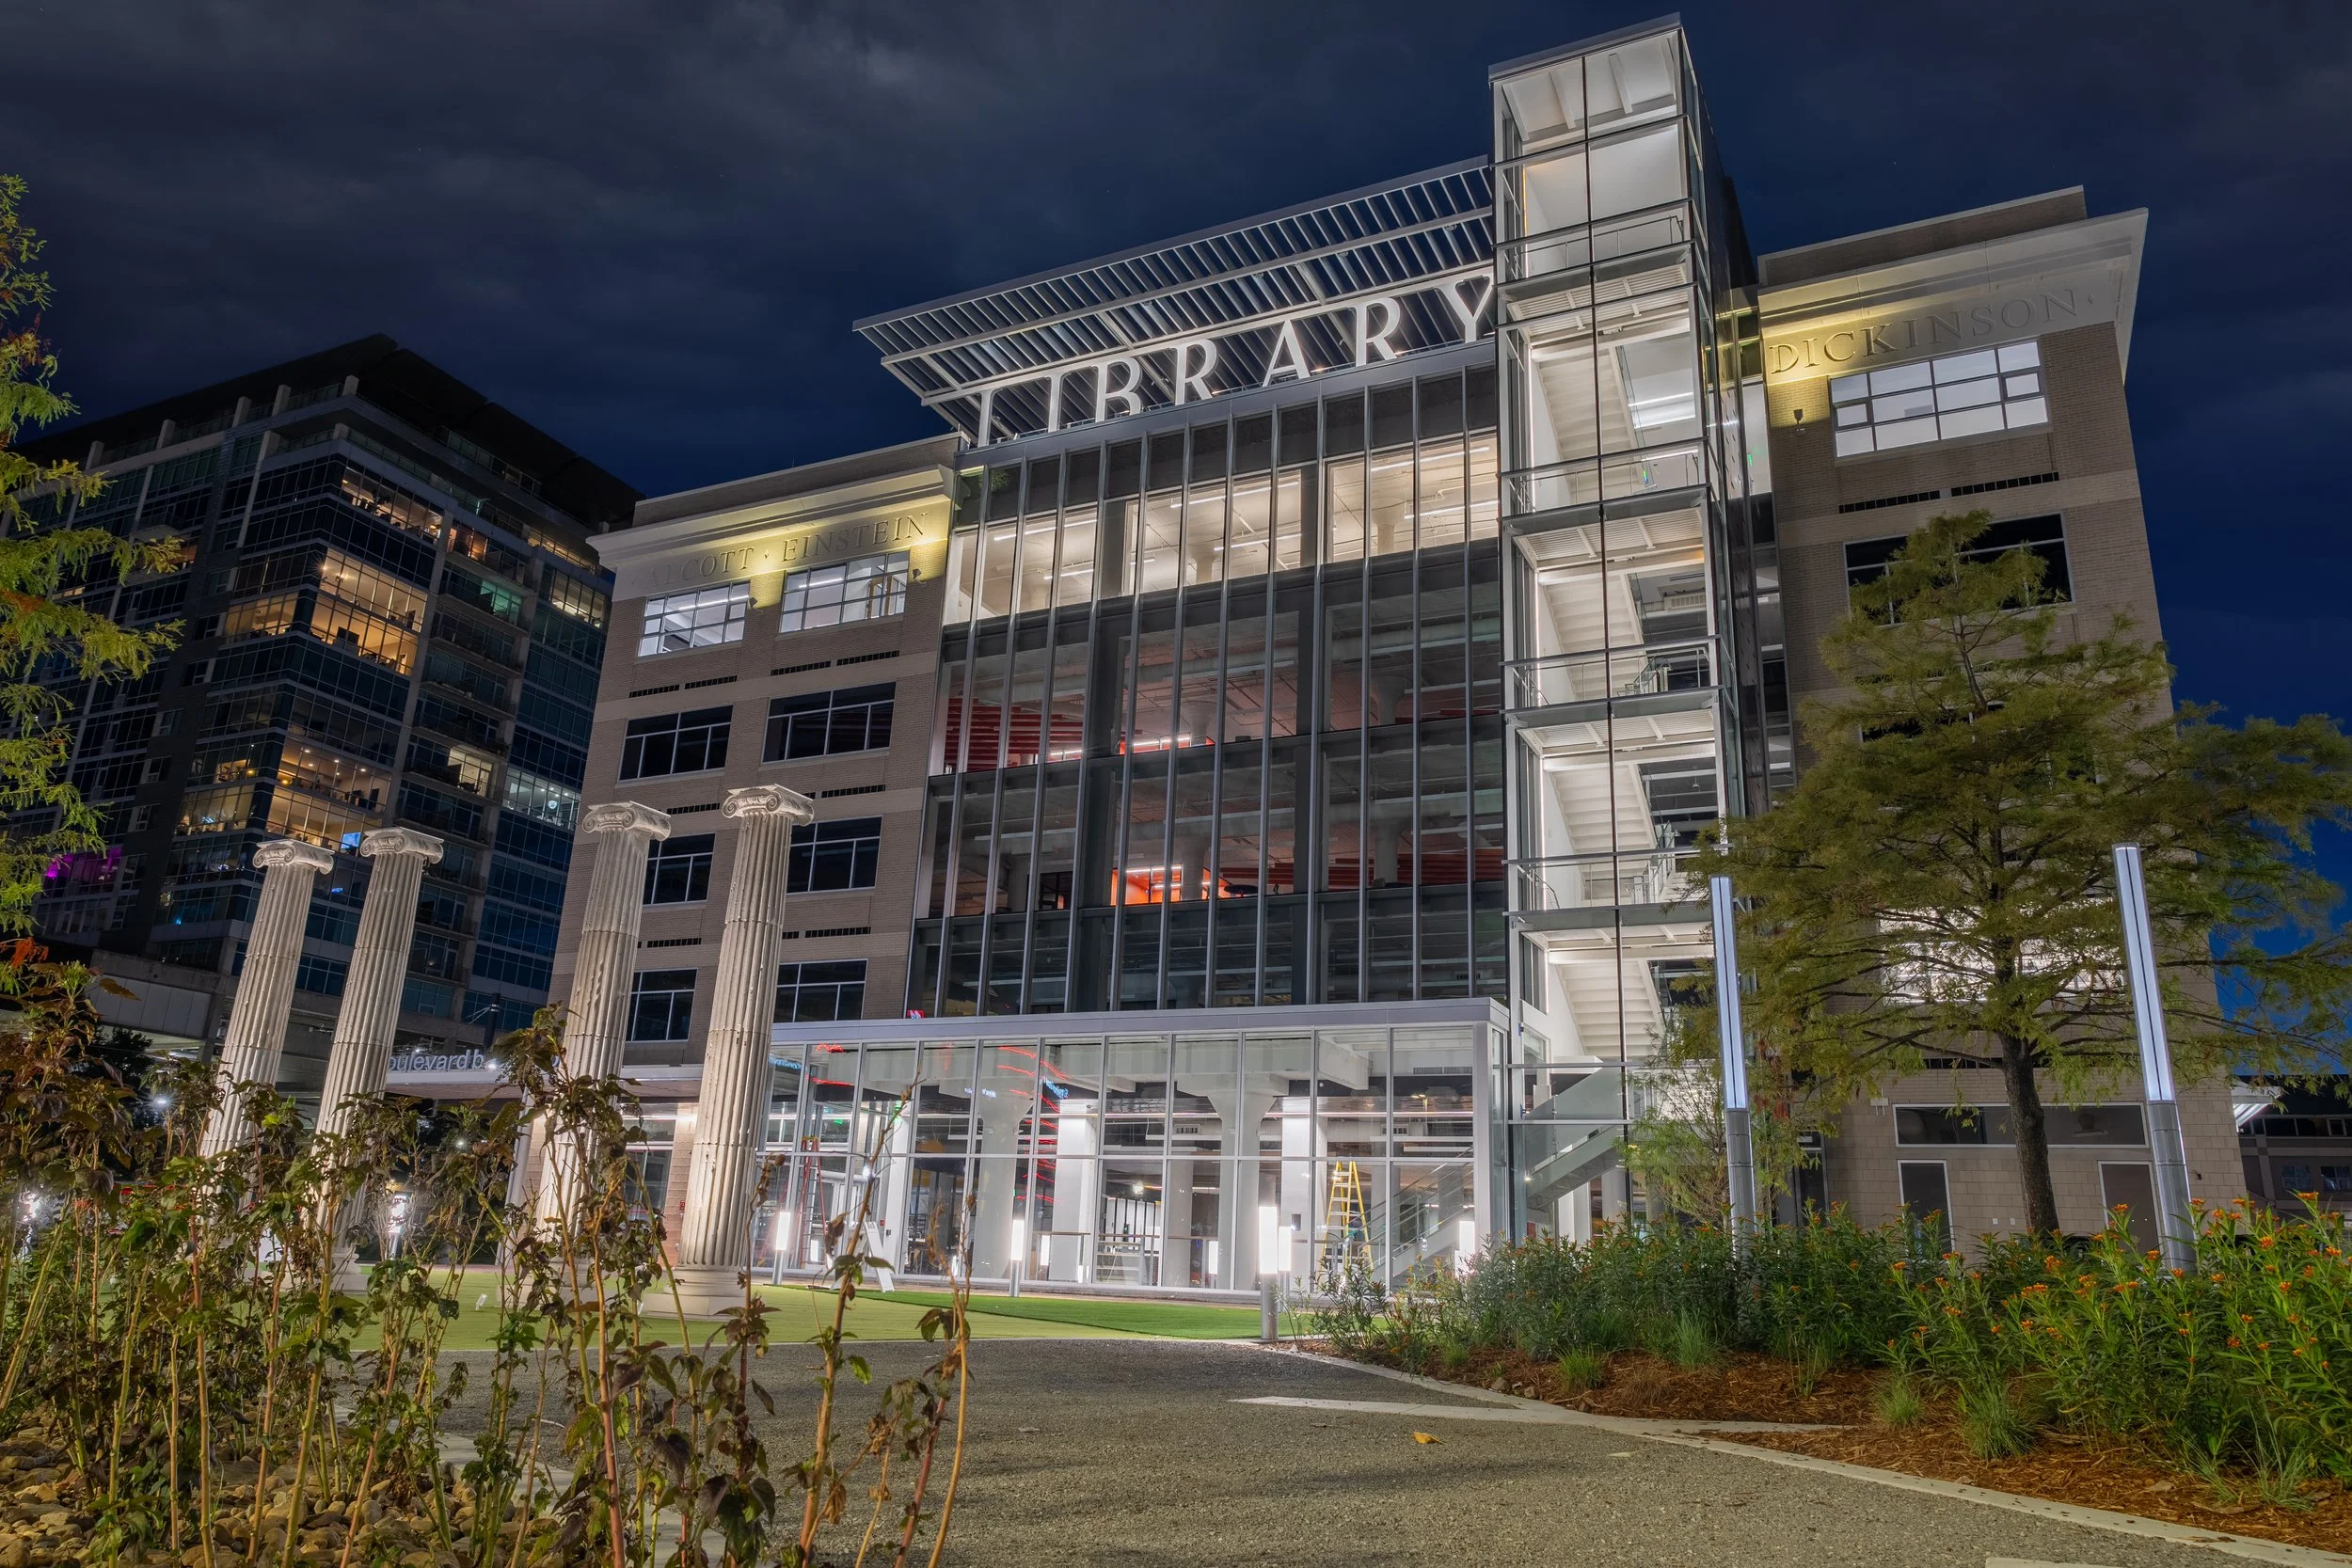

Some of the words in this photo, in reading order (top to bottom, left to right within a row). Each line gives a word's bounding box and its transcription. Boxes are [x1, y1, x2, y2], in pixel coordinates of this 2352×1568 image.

[1769, 288, 2080, 374] DICKINSON
[644, 546, 755, 589] ALCOTT
[781, 512, 929, 562] EINSTEIN
[389, 1049, 471, 1070] oulevard
